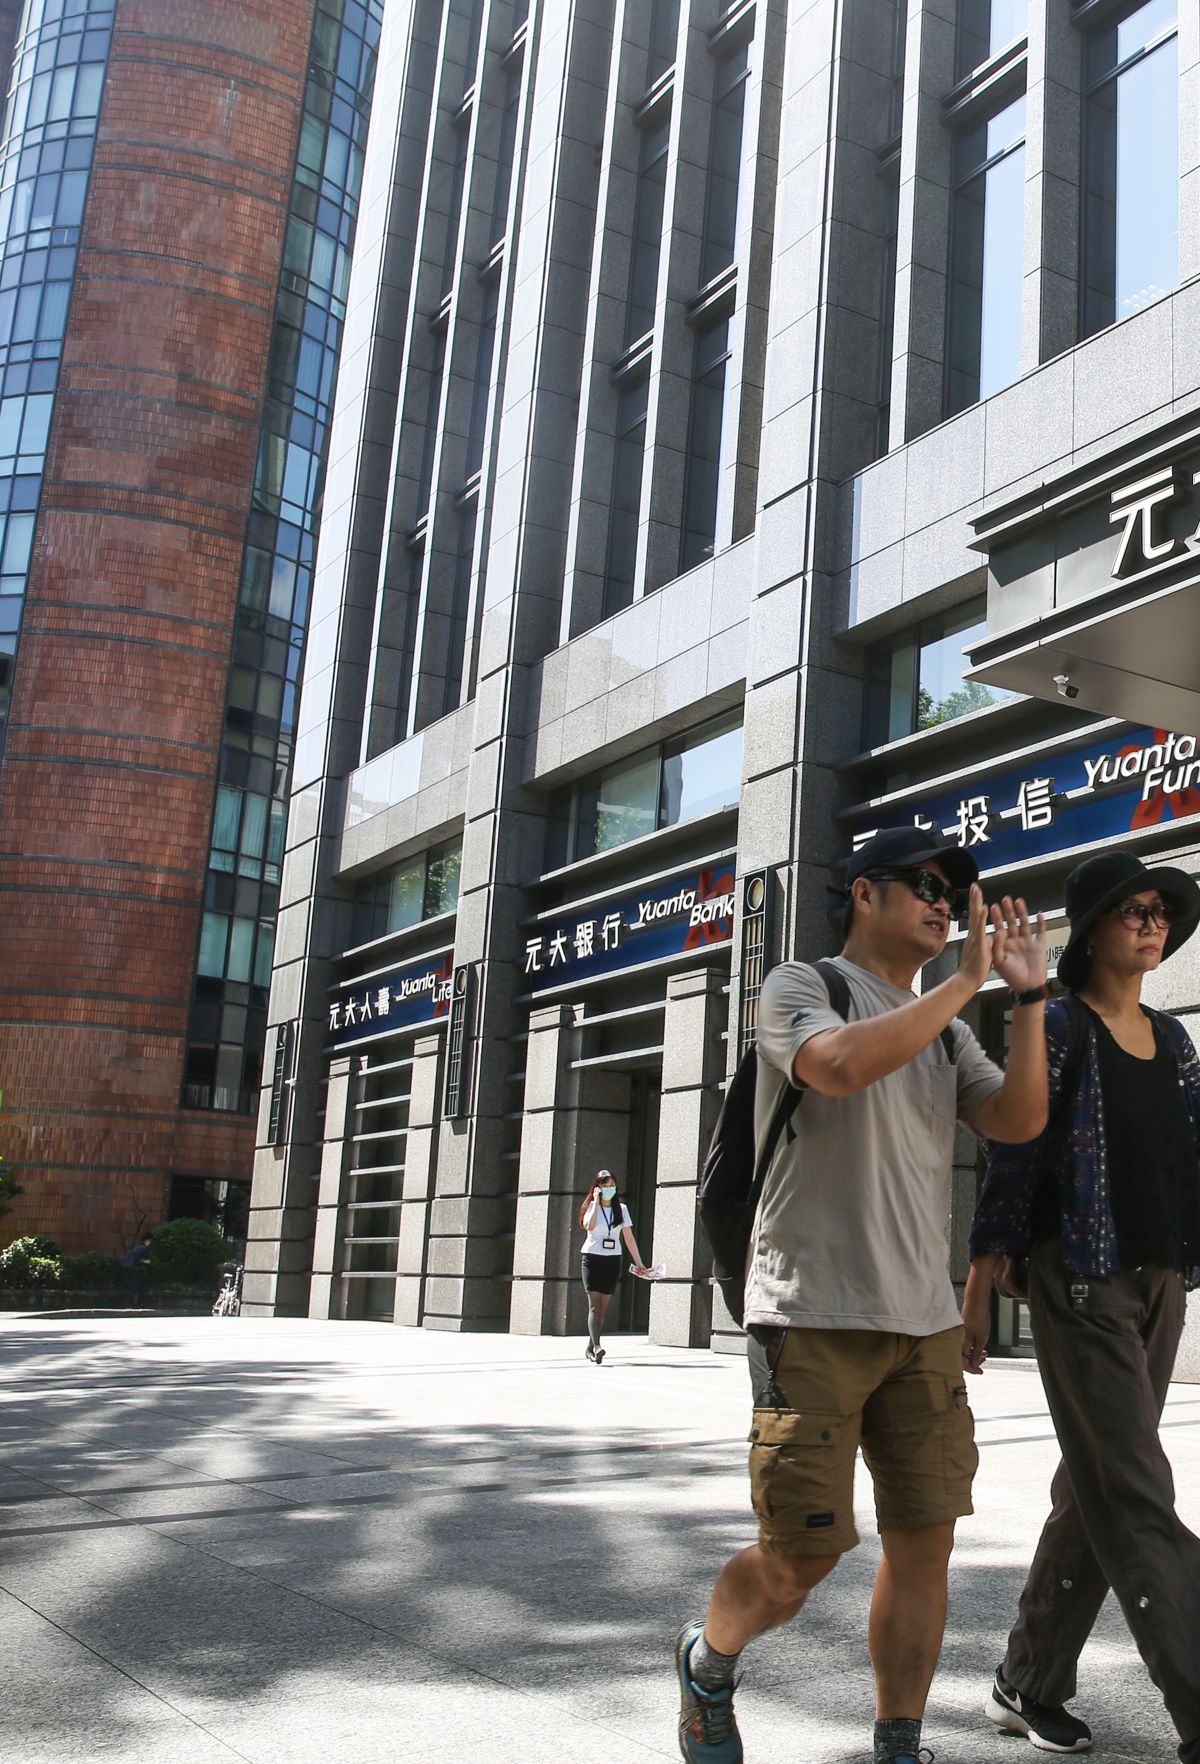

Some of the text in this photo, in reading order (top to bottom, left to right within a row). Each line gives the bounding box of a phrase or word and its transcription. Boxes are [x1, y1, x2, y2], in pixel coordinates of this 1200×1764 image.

[1084, 732, 1197, 788] Yuanta
[853, 777, 1052, 851] 投信
[637, 888, 697, 925] Yuanta
[689, 894, 735, 927] Bank
[525, 912, 622, 974] 元大銀行
[401, 971, 437, 997] Yuanta
[329, 986, 390, 1031] 元大人壽
